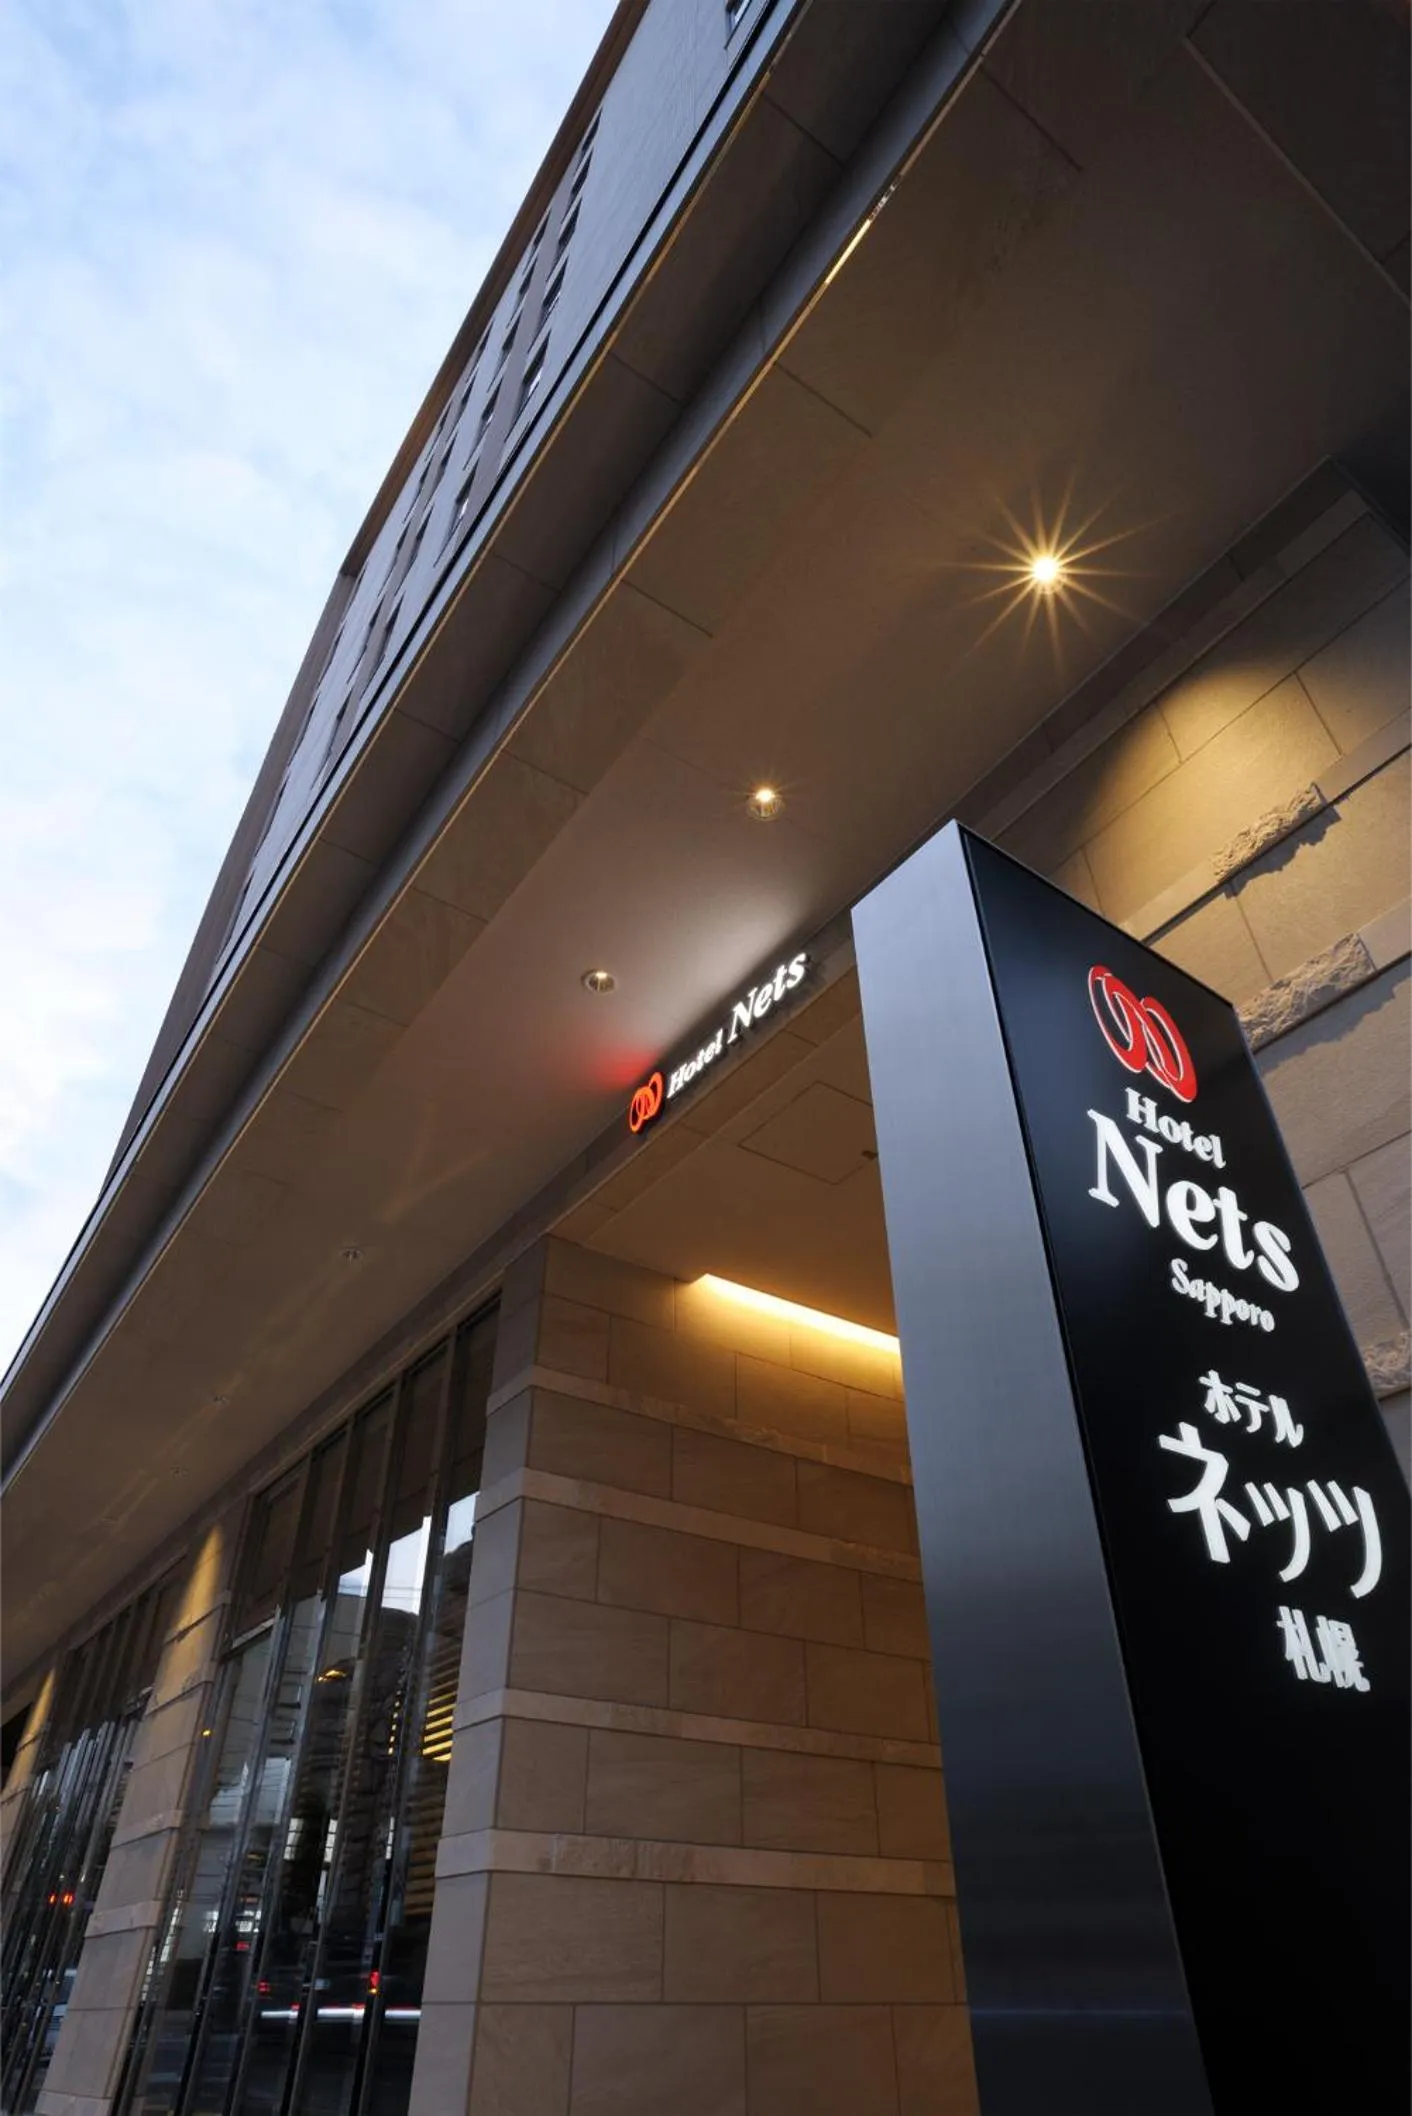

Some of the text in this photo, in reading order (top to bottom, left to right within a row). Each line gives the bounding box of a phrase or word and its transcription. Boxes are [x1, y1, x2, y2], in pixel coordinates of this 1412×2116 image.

[666, 952, 807, 1099] Hotel Nets
[1124, 1086, 1227, 1169] Hotel
[1086, 1108, 1300, 1292] Nets
[1170, 1257, 1275, 1333] Sapporo
[1198, 1369, 1304, 1448] ホテル
[1276, 1605, 1371, 1692] 札幌
